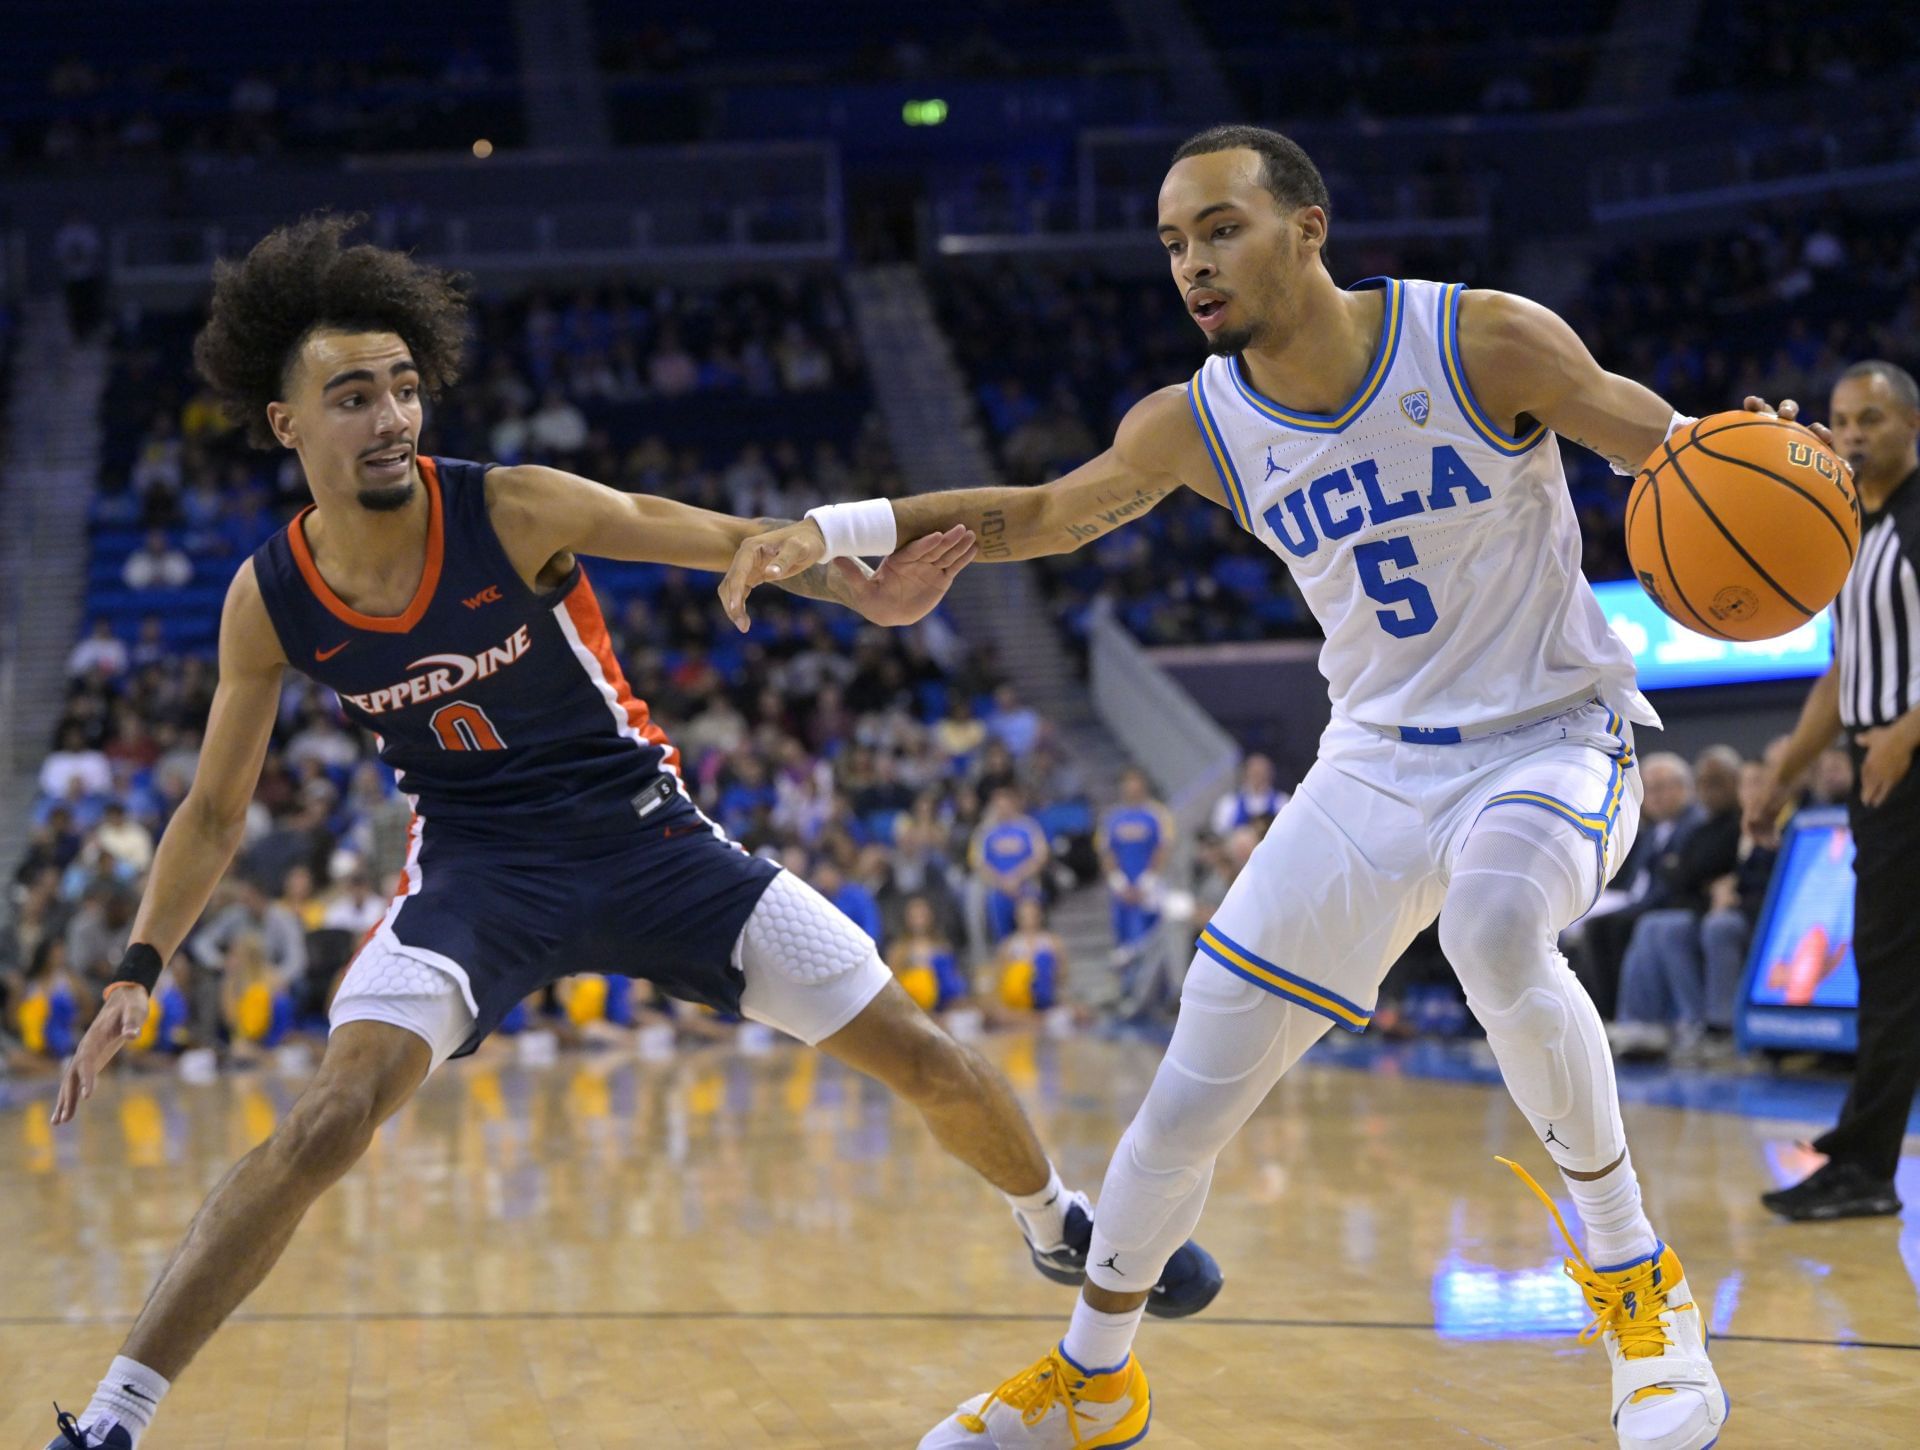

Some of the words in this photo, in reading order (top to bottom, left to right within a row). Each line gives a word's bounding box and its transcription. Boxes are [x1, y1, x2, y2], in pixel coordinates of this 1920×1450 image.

[1411, 405, 1427, 421] 12
[1263, 445, 1492, 558] UCLA
[462, 585, 503, 610] WCC
[1353, 535, 1439, 639] 5
[341, 624, 532, 715] EPPERDINE
